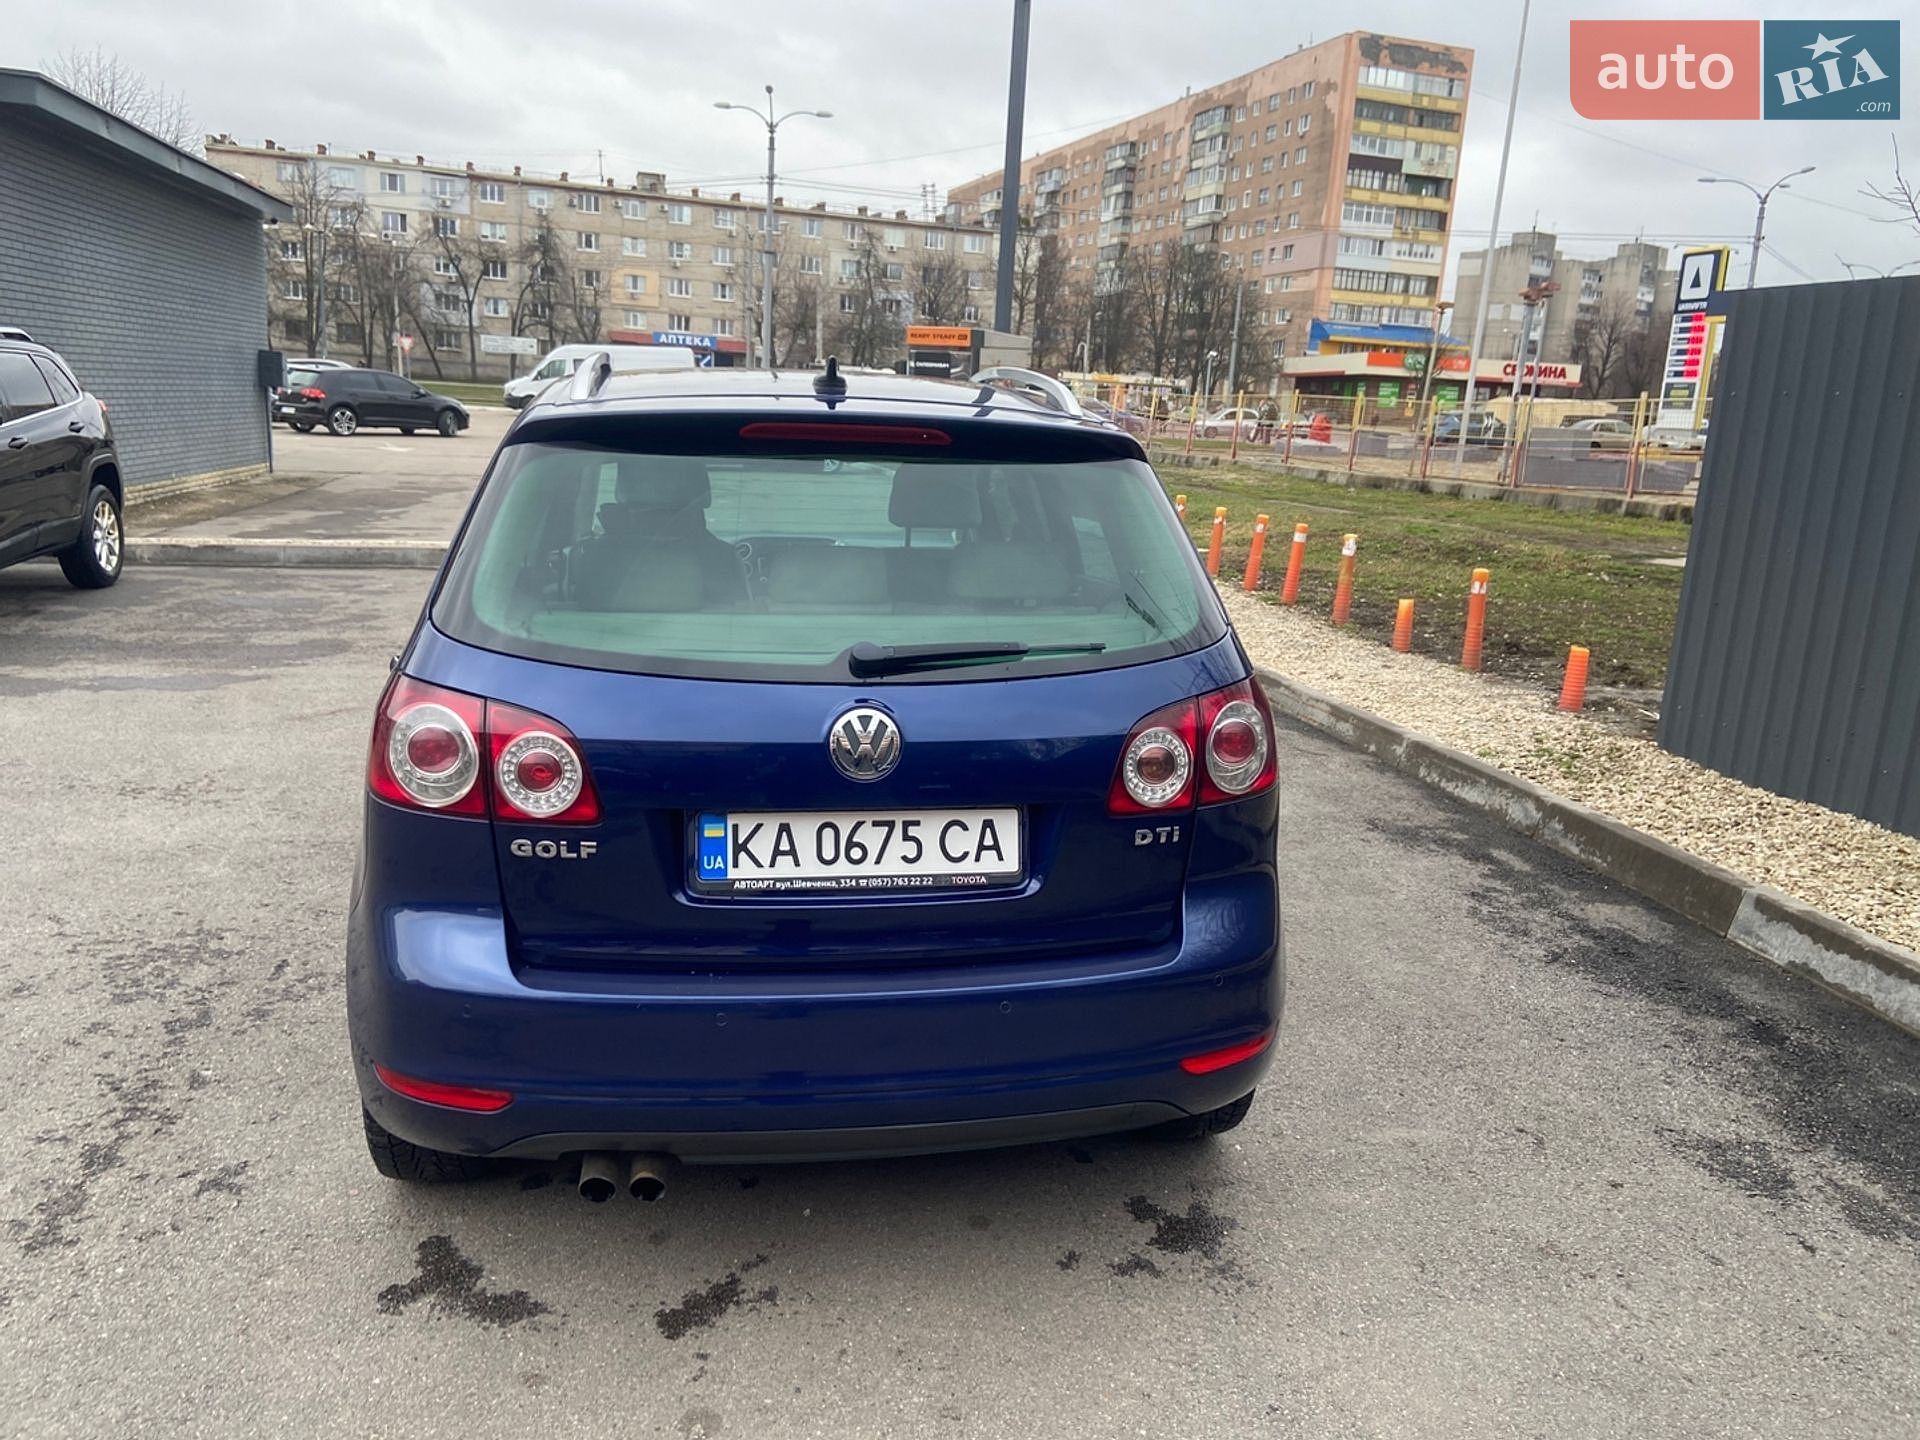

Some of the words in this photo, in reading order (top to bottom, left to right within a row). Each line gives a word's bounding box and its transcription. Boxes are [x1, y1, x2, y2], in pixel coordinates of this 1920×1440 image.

[659, 333, 712, 347] АПТЕКА
[510, 839, 598, 859] GOLF
[732, 822, 801, 868] KA
[815, 820, 923, 865] 0675
[938, 818, 1004, 863] CA
[703, 855, 725, 870] UA
[733, 880, 775, 889] АВТОАРТ
[840, 879, 856, 887] 334
[869, 877, 891, 887] (057)
[910, 877, 921, 886] 22
[922, 876, 933, 885] 22
[951, 875, 987, 884] TOYOTA
